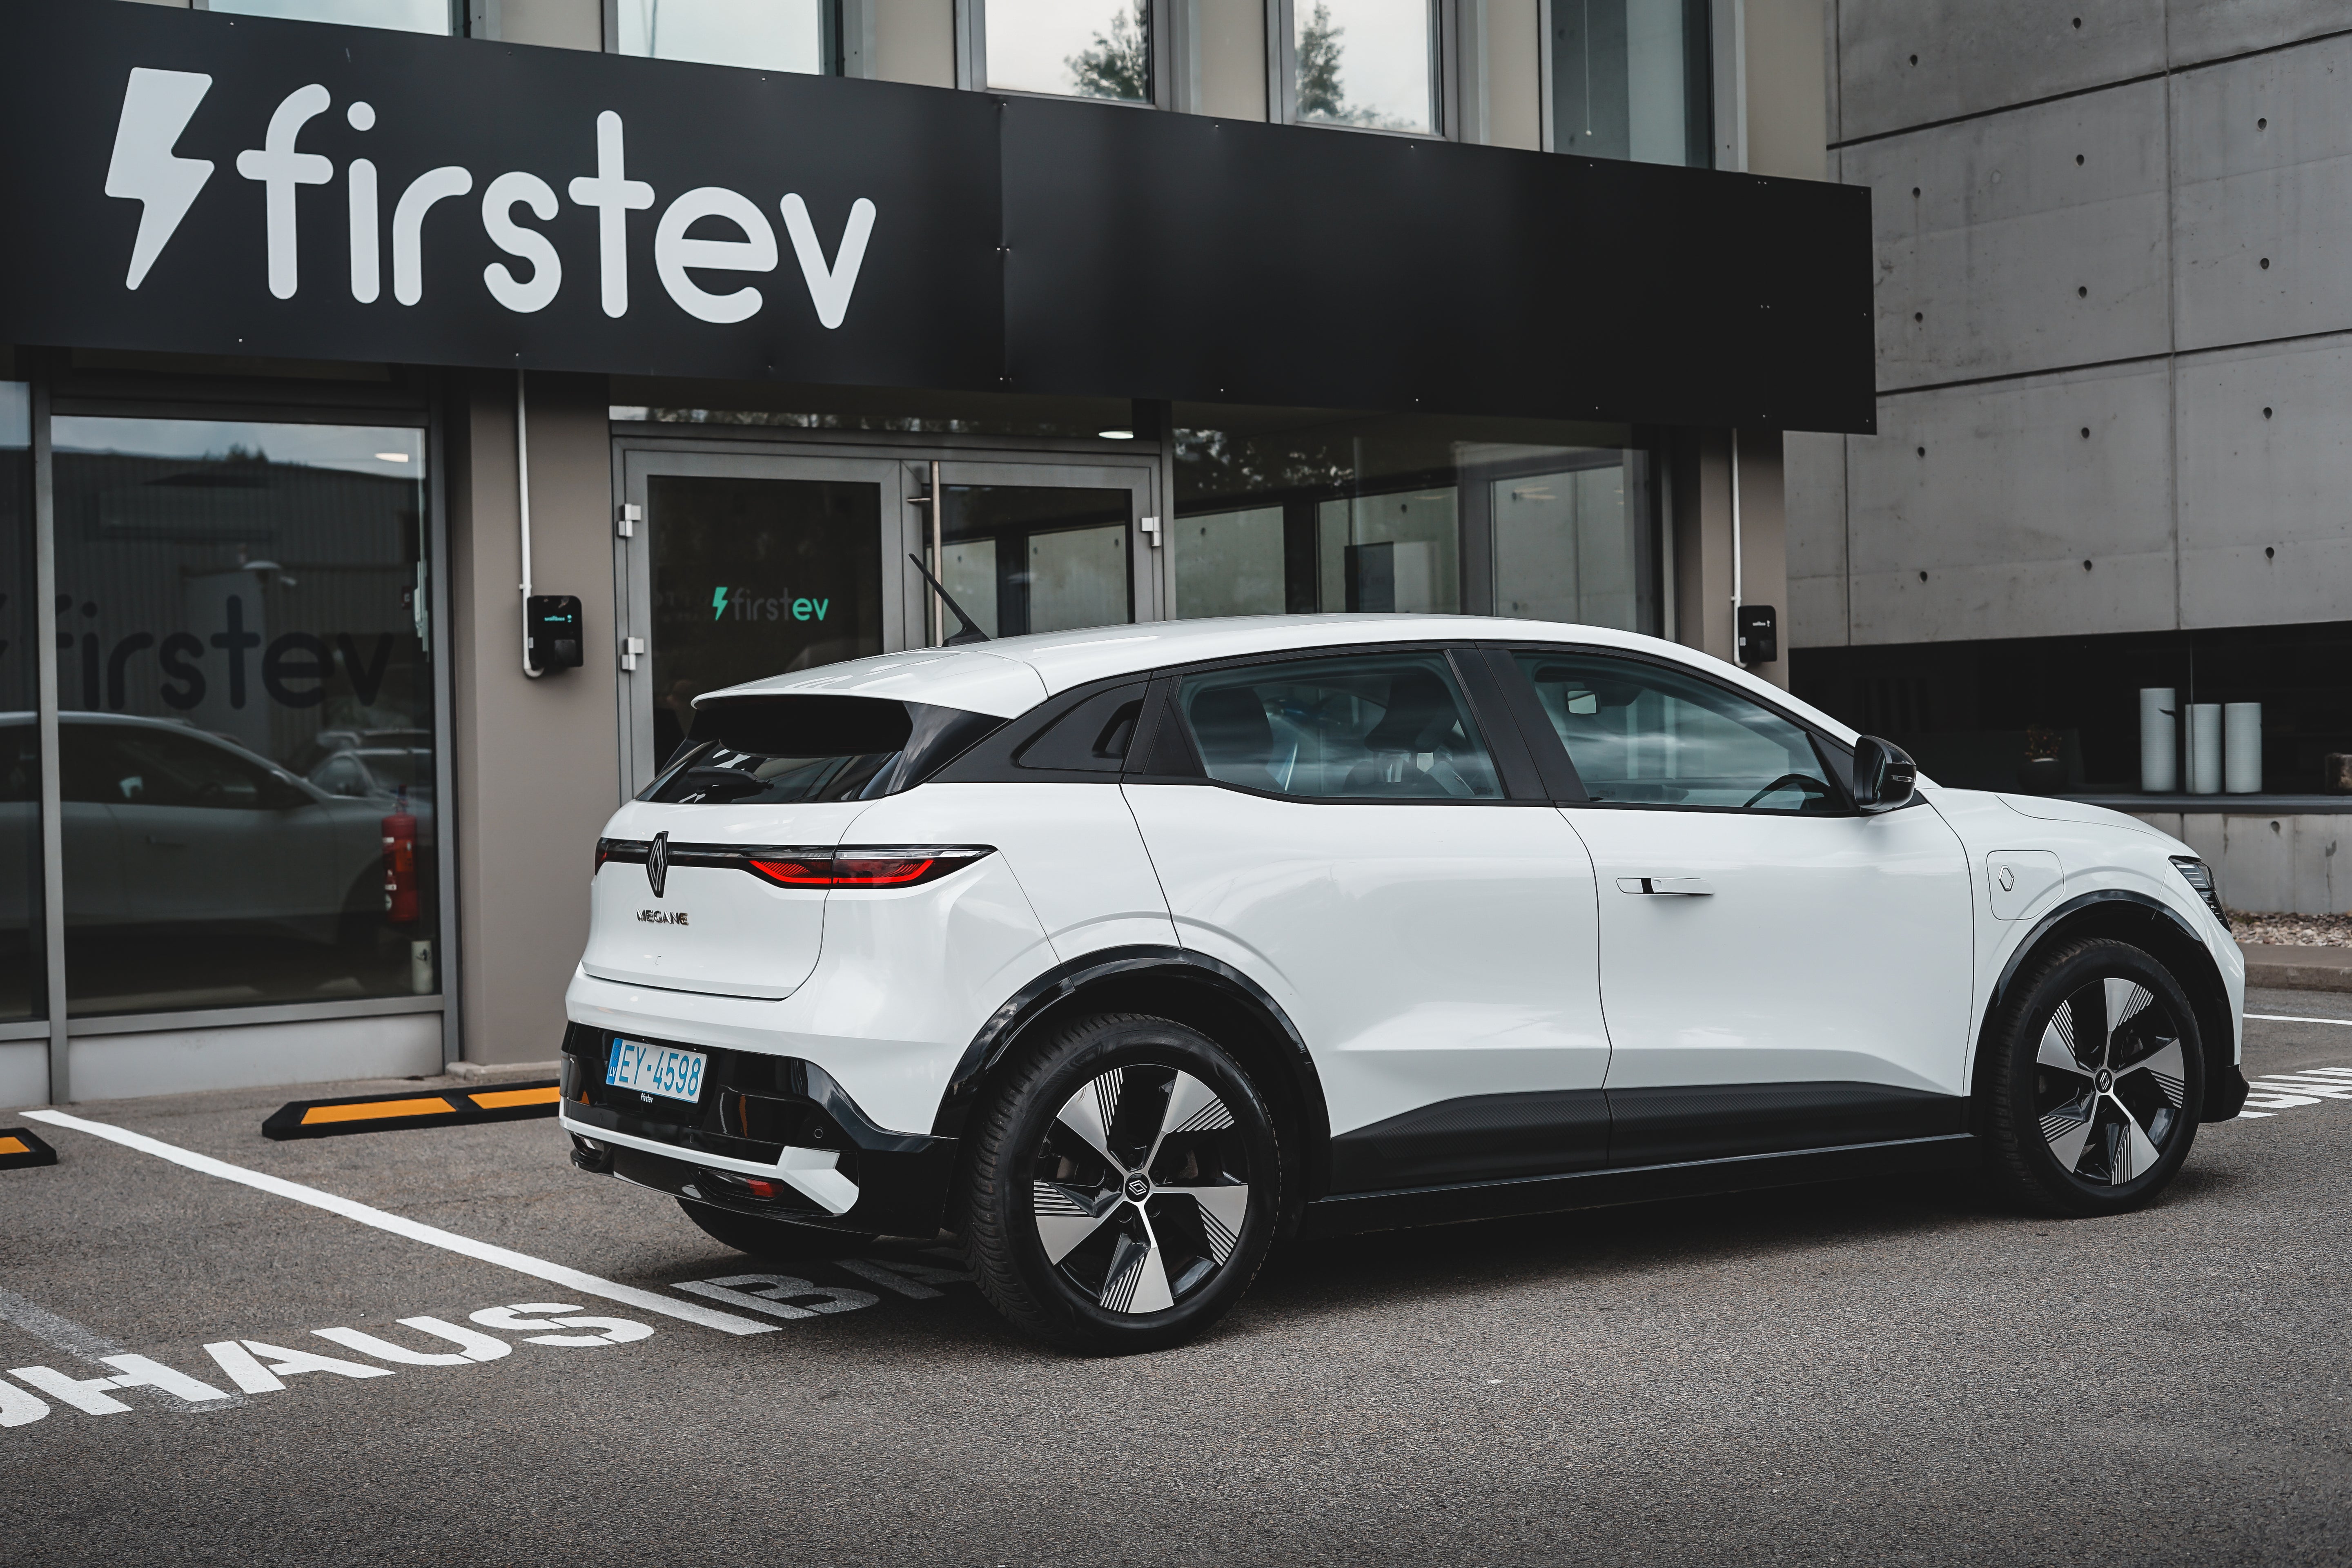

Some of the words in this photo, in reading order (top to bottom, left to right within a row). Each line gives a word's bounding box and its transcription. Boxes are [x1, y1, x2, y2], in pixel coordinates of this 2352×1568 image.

[236, 83, 876, 329] firstev
[731, 587, 829, 621] firstev
[636, 908, 689, 926] MEGANE
[609, 1066, 617, 1077] LV
